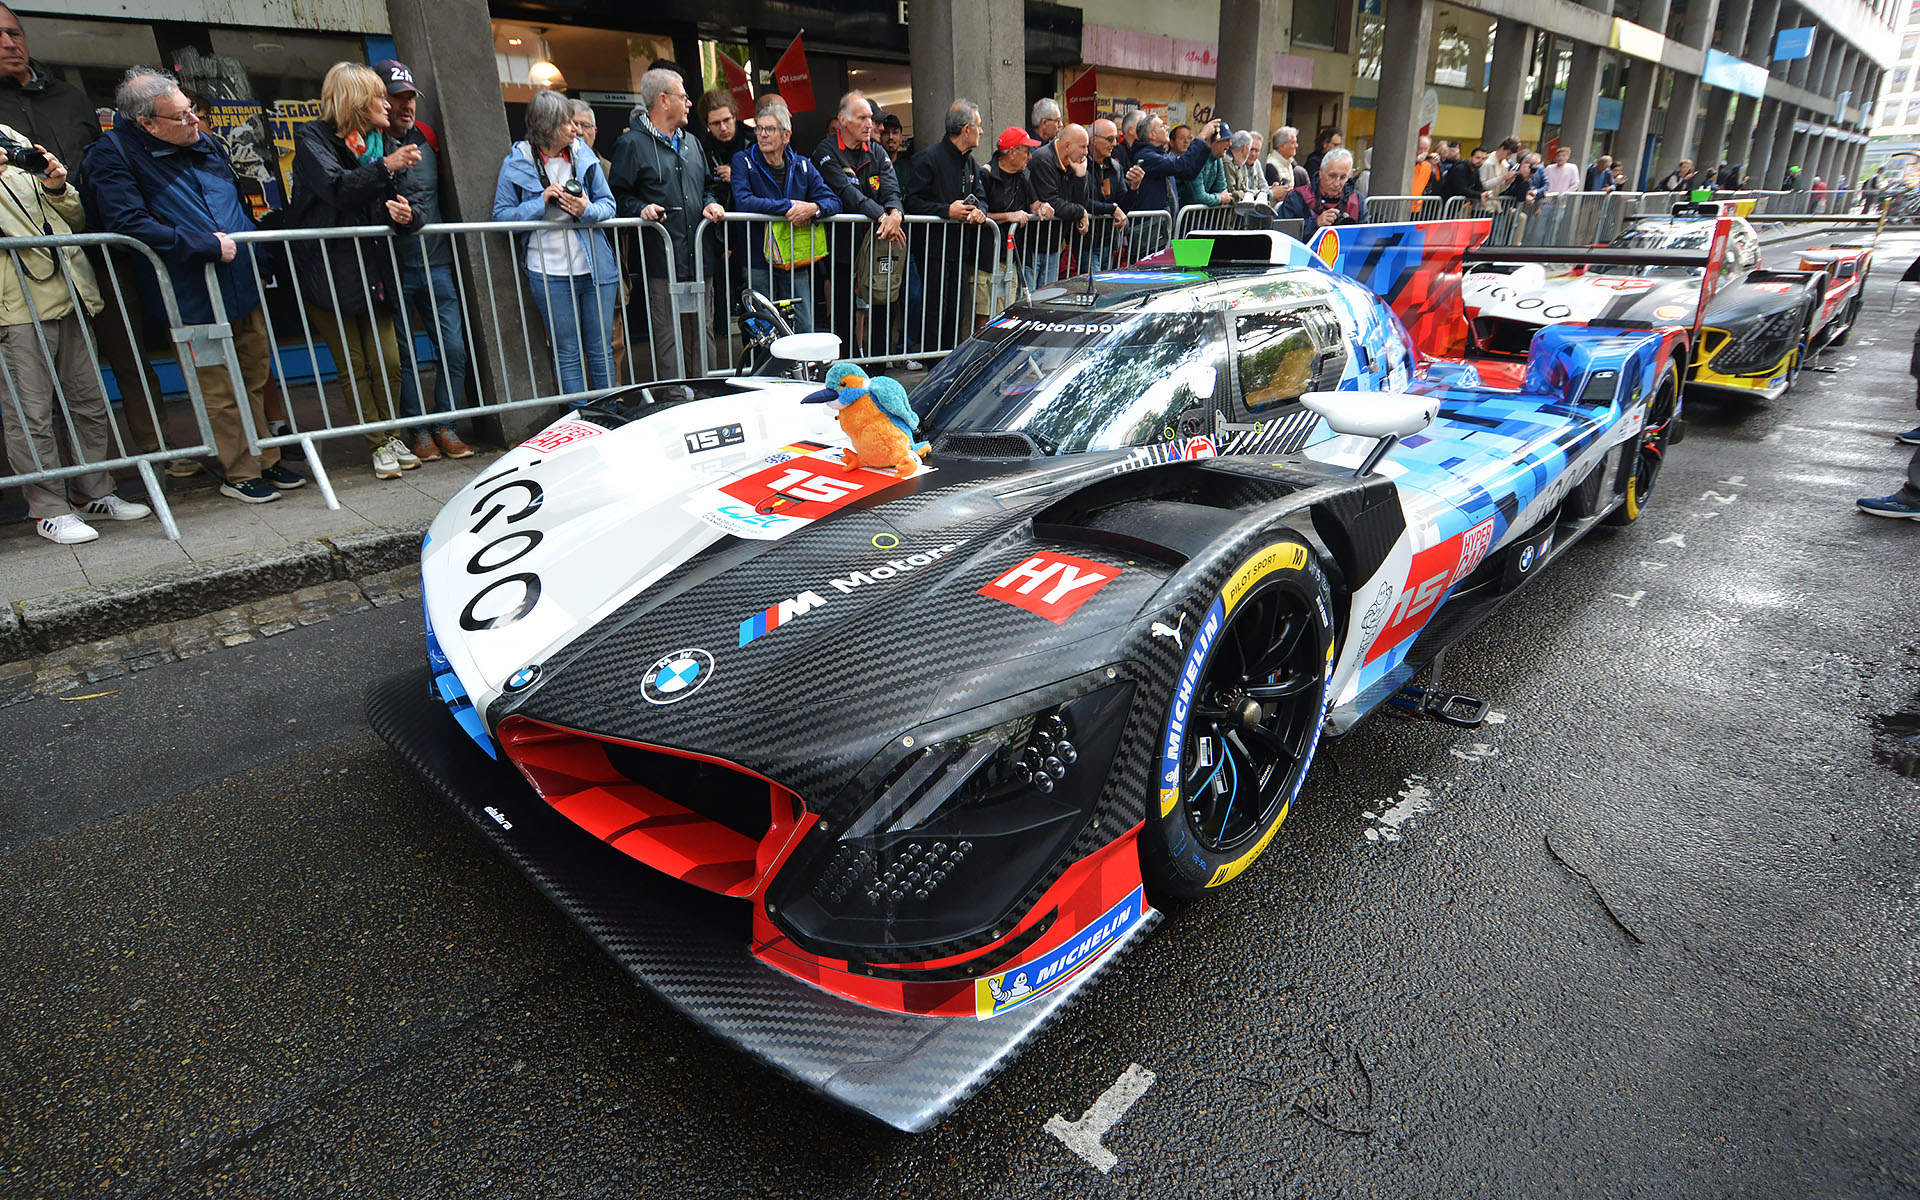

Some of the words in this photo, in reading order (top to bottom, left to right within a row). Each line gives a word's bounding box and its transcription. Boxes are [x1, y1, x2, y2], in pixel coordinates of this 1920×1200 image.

[221, 105, 262, 115] RETRAITE
[685, 430, 720, 450] 15
[766, 468, 864, 503] 15
[1463, 524, 1492, 555] HYPER
[994, 557, 1108, 605] HY
[1230, 571, 1252, 600] PILOT
[1252, 553, 1277, 576] SPORT
[1292, 547, 1304, 566] M
[1455, 544, 1487, 582] CAR
[1391, 568, 1450, 629] 15
[646, 651, 693, 684] BMW
[1167, 613, 1218, 760] MICHELIN
[1036, 905, 1132, 985] MICHELIN
